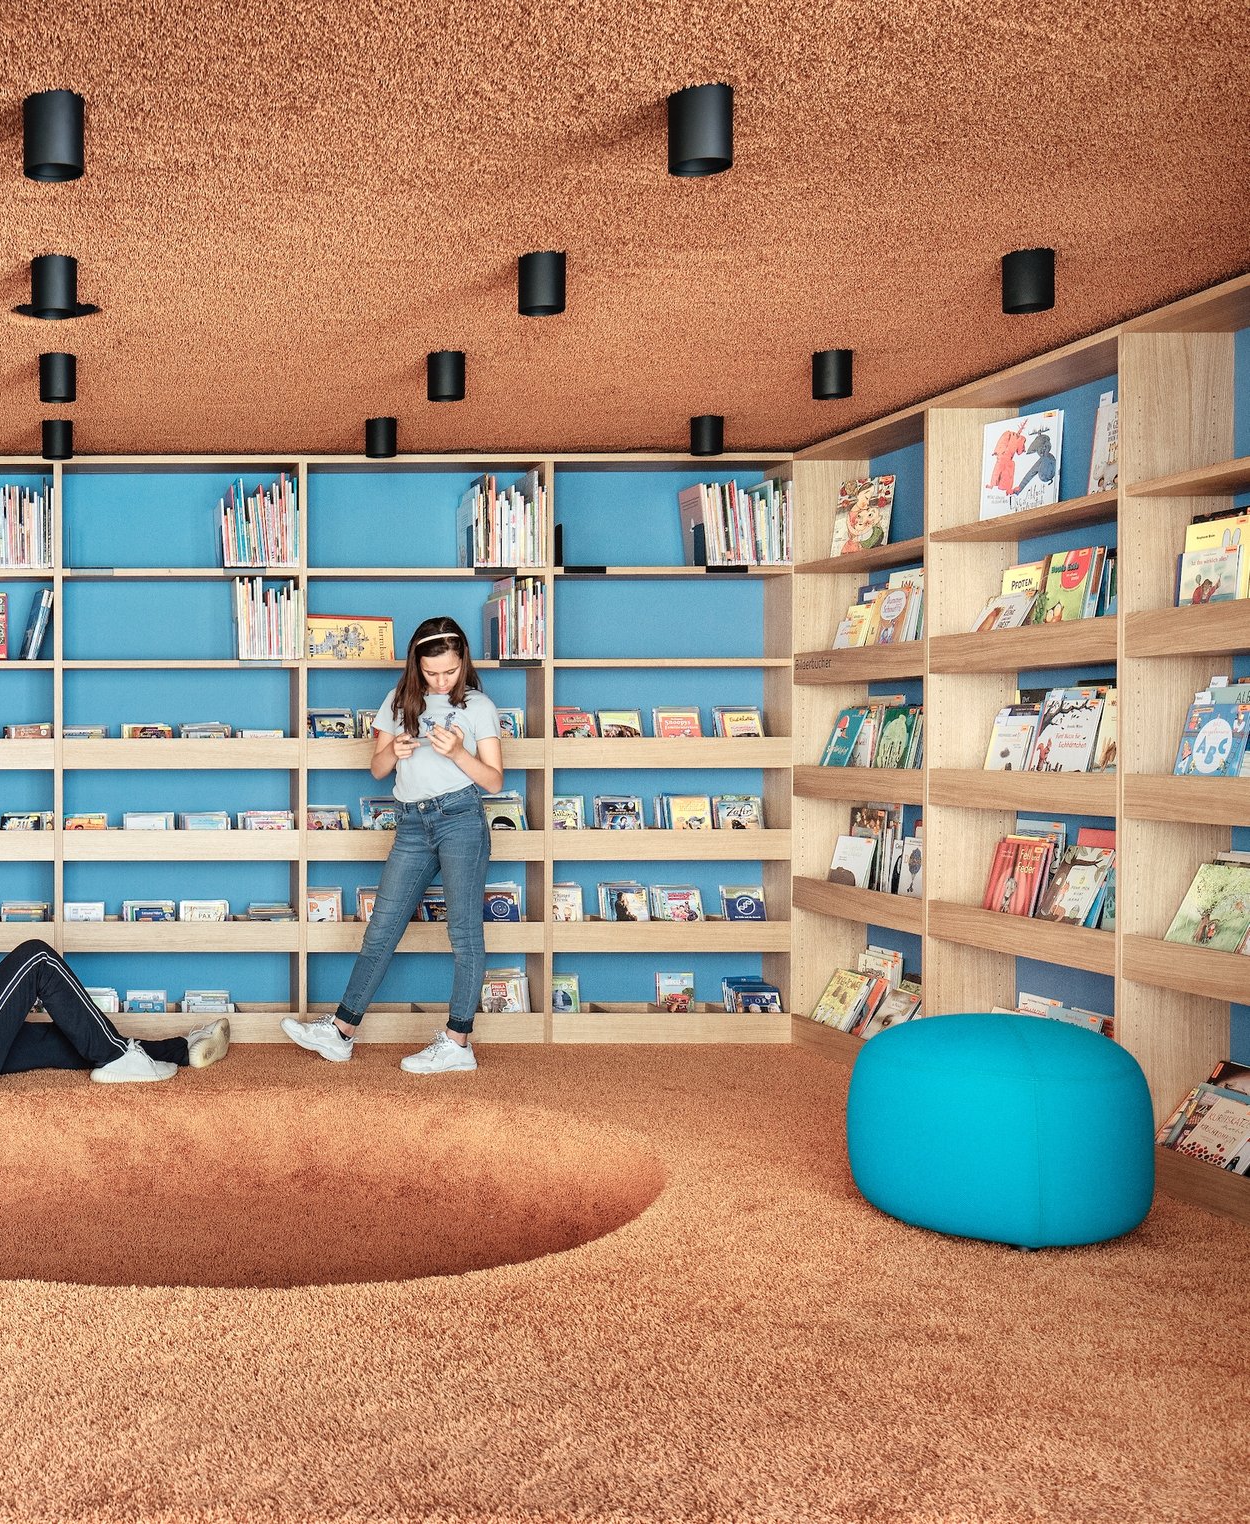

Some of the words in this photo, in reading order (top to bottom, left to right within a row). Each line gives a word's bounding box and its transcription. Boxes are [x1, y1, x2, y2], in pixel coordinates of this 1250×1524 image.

[1011, 577, 1033, 591] PFOTEN
[726, 804, 753, 818] Zafir
[1017, 862, 1036, 874] Feder
[199, 911, 212, 920] PAX
